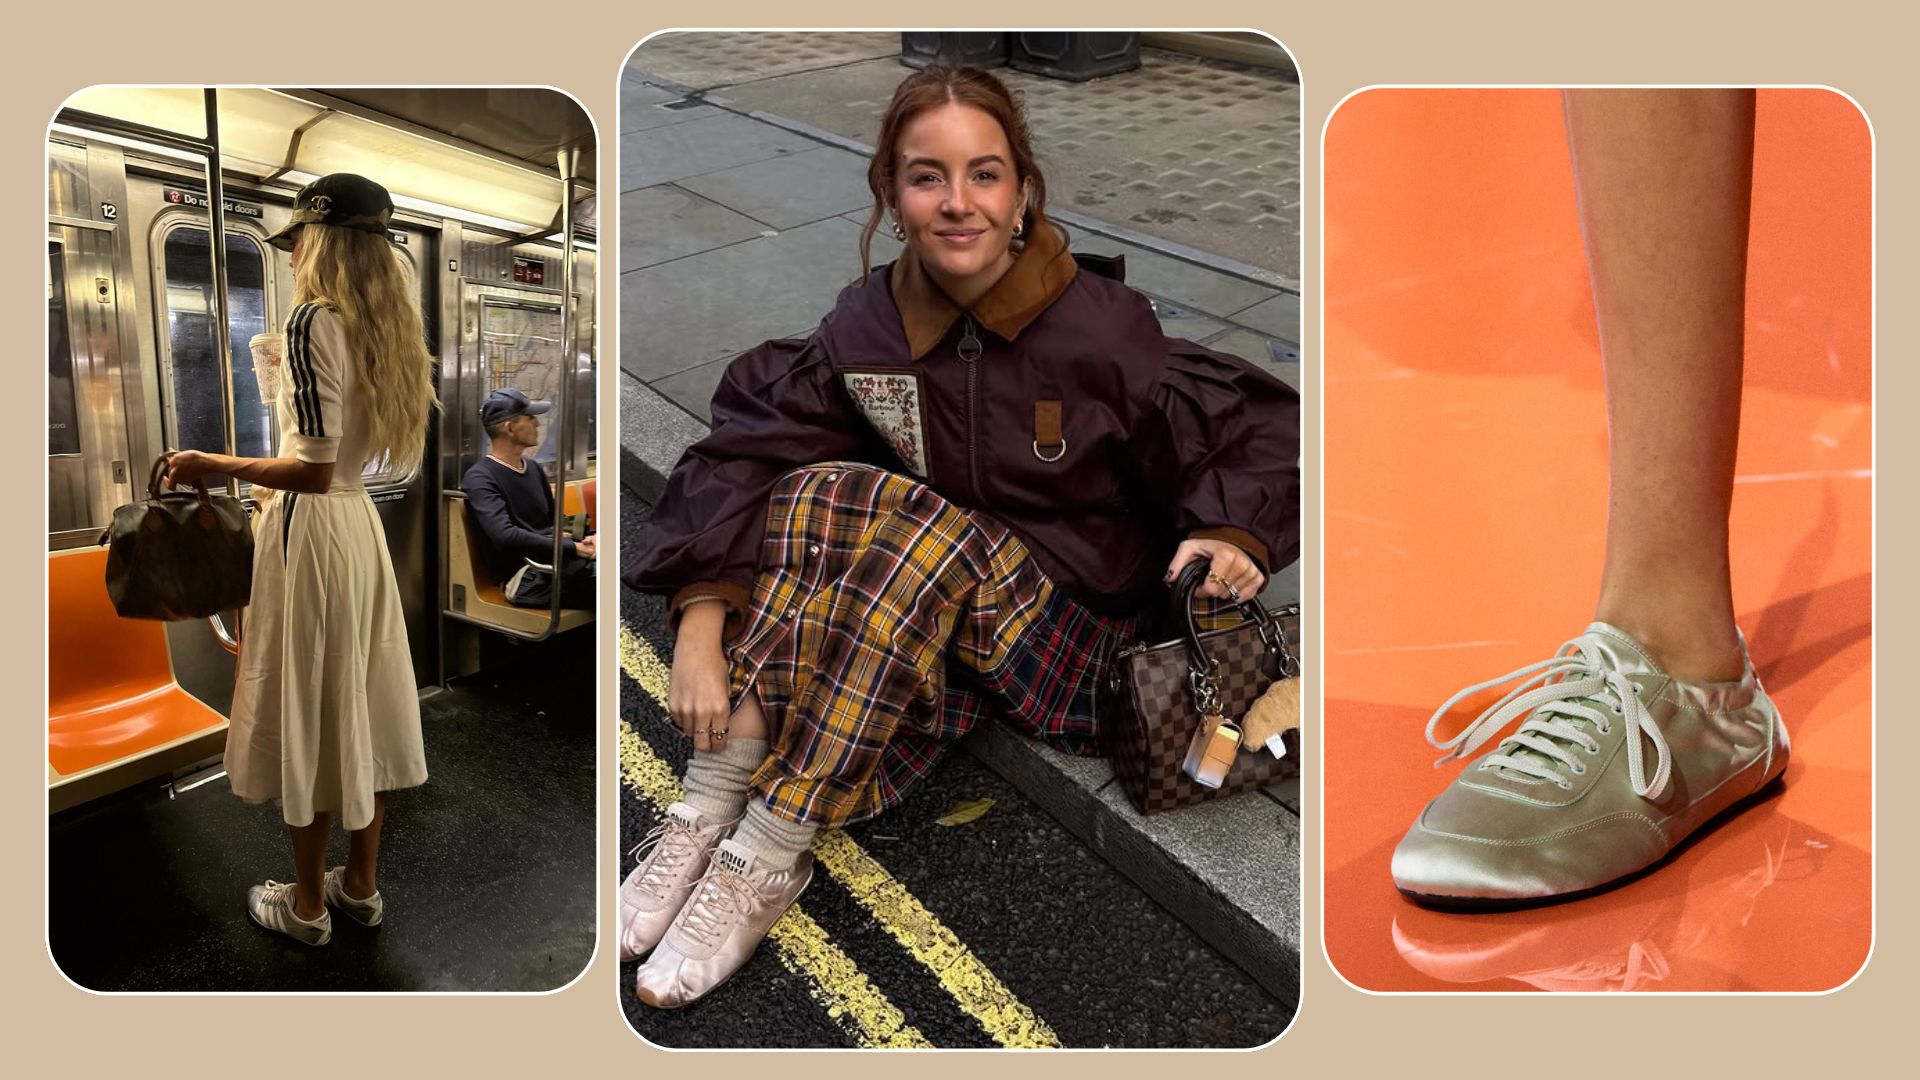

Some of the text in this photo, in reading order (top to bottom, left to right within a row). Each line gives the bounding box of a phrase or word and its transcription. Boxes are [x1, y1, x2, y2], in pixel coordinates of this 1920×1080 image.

[101, 204, 117, 218] 12
[184, 194, 198, 204] Do
[234, 204, 258, 216] doors
